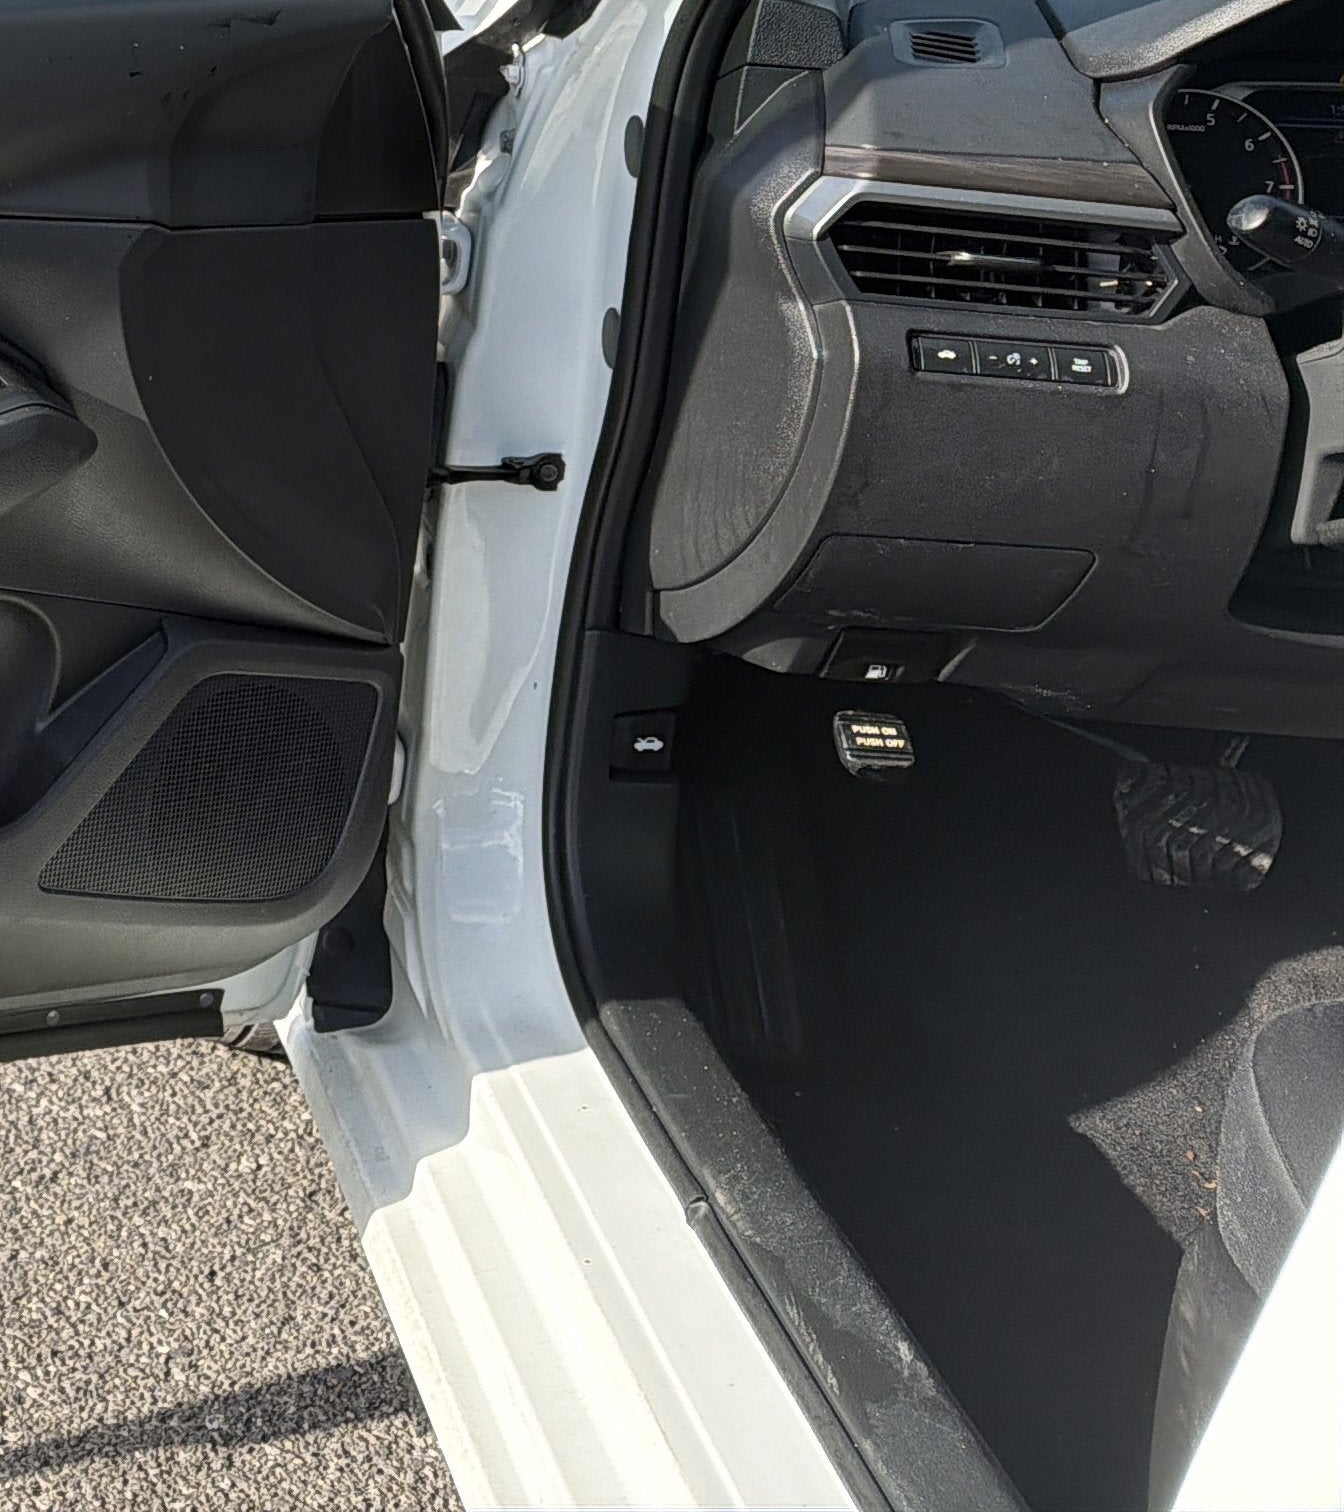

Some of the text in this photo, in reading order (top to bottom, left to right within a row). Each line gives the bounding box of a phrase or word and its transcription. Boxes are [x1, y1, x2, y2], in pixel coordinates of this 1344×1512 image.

[1206, 113, 1216, 126] 5
[1244, 139, 1255, 152] 6
[1264, 181, 1275, 194] 7
[1294, 233, 1314, 248] AUTO
[1071, 364, 1092, 373] RESET
[852, 724, 898, 736] PUSH ON
[856, 736, 906, 749] PUSH OFF
